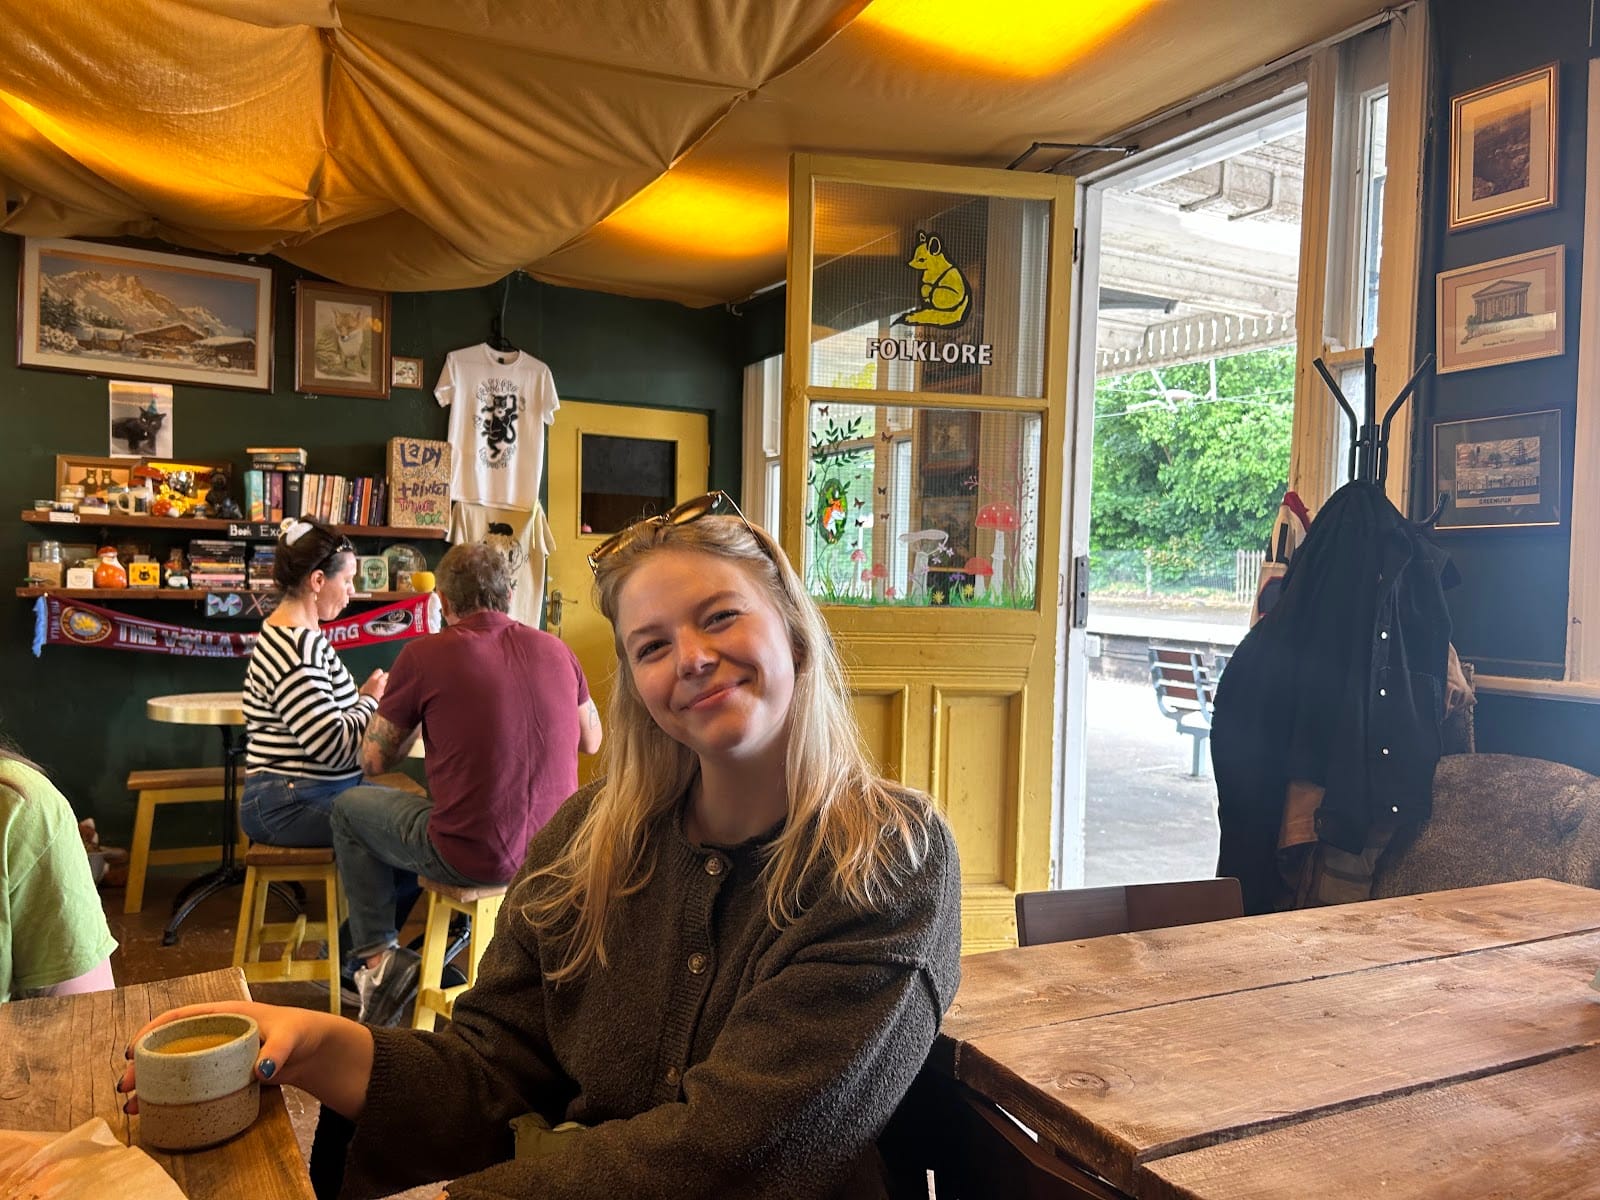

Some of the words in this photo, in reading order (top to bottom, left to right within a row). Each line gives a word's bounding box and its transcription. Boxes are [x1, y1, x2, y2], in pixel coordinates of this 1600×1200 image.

[866, 338, 992, 365] FOLKLORE
[229, 524, 252, 536] Book
[116, 622, 157, 645] THE
